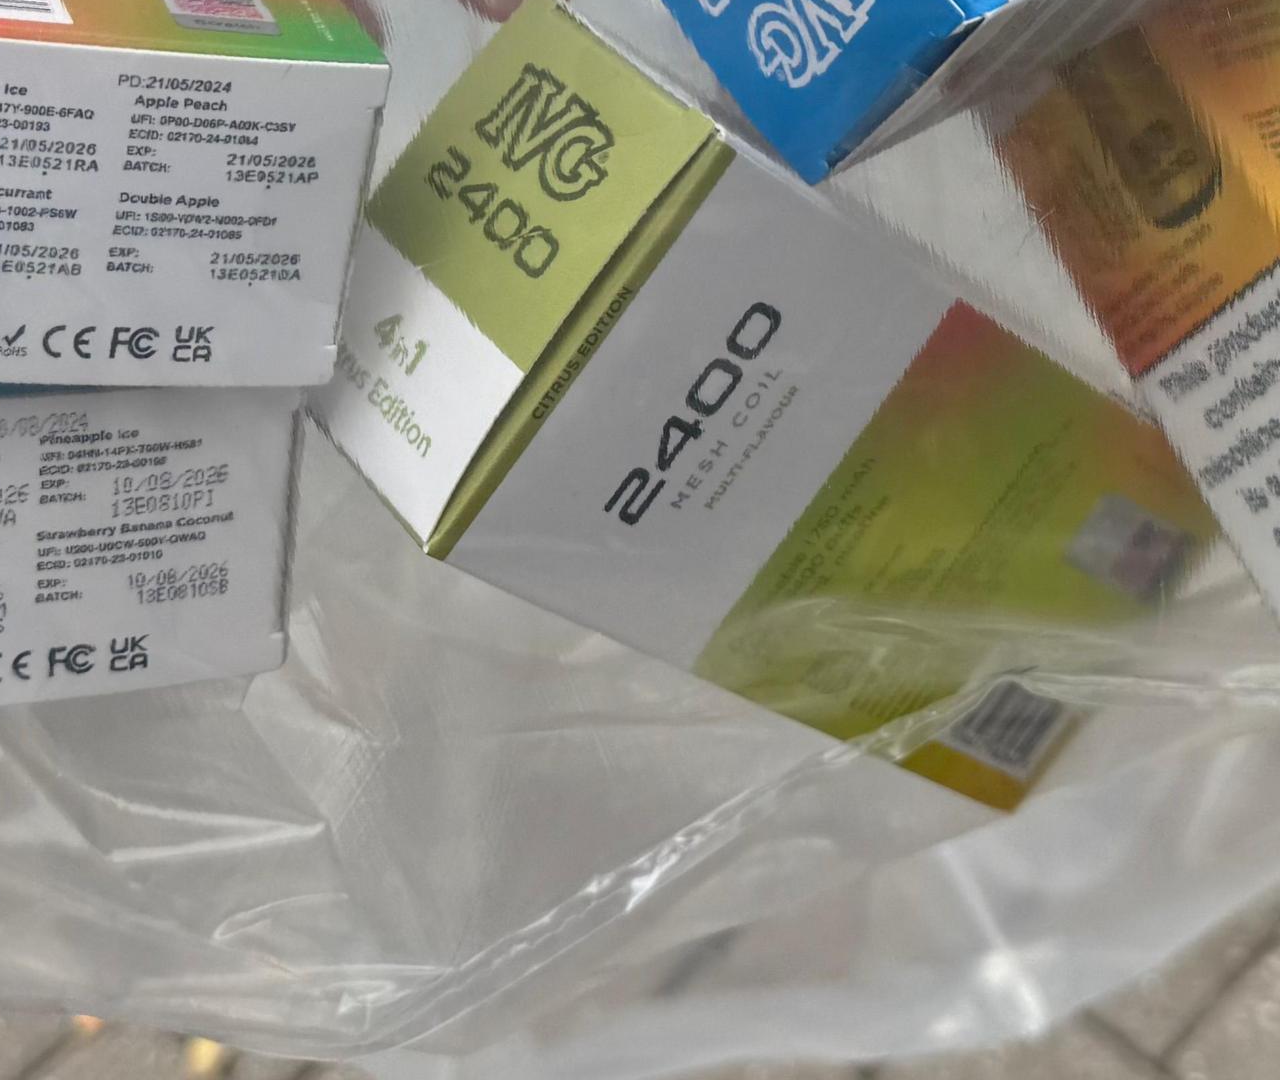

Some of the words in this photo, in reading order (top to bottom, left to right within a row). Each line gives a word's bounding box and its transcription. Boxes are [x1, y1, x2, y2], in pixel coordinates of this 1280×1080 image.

[4, 83, 28, 96] Ice
[135, 94, 179, 109] Apple
[184, 98, 227, 111] Peach
[130, 113, 155, 125] UFI:
[129, 129, 162, 141] ECID:
[475, 62, 617, 201] IVG
[127, 145, 156, 156] EXP:
[123, 160, 170, 173] BATCH:
[226, 153, 316, 168] 21/05/2026
[226, 169, 319, 184] 13E0521AP
[120, 192, 172, 205] Double
[175, 194, 220, 208] Apple
[116, 211, 141, 221] UFI:
[426, 145, 560, 278] 2400
[106, 262, 154, 273] BATCH:
[210, 252, 300, 266] 21/05/2026
[42, 324, 97, 359] CE
[175, 325, 215, 344] UK
[172, 344, 212, 363] CA
[532, 356, 583, 421] CITRUS
[576, 285, 634, 360] EDITION
[1157, 359, 1211, 405] This
[368, 376, 432, 457] Edition
[604, 300, 783, 526] 2400
[40, 430, 113, 445] Pineapple
[118, 428, 139, 439] Ice
[670, 439, 729, 511] MESH
[731, 366, 785, 431] COIL
[703, 384, 801, 513] MULTI-FLAVOUR
[36, 525, 116, 541] Strawberry
[120, 520, 173, 535] Banana
[176, 511, 234, 526] Coconut
[128, 560, 229, 589] 10/08/2026
[109, 633, 150, 654] UK
[109, 652, 148, 672] CA
